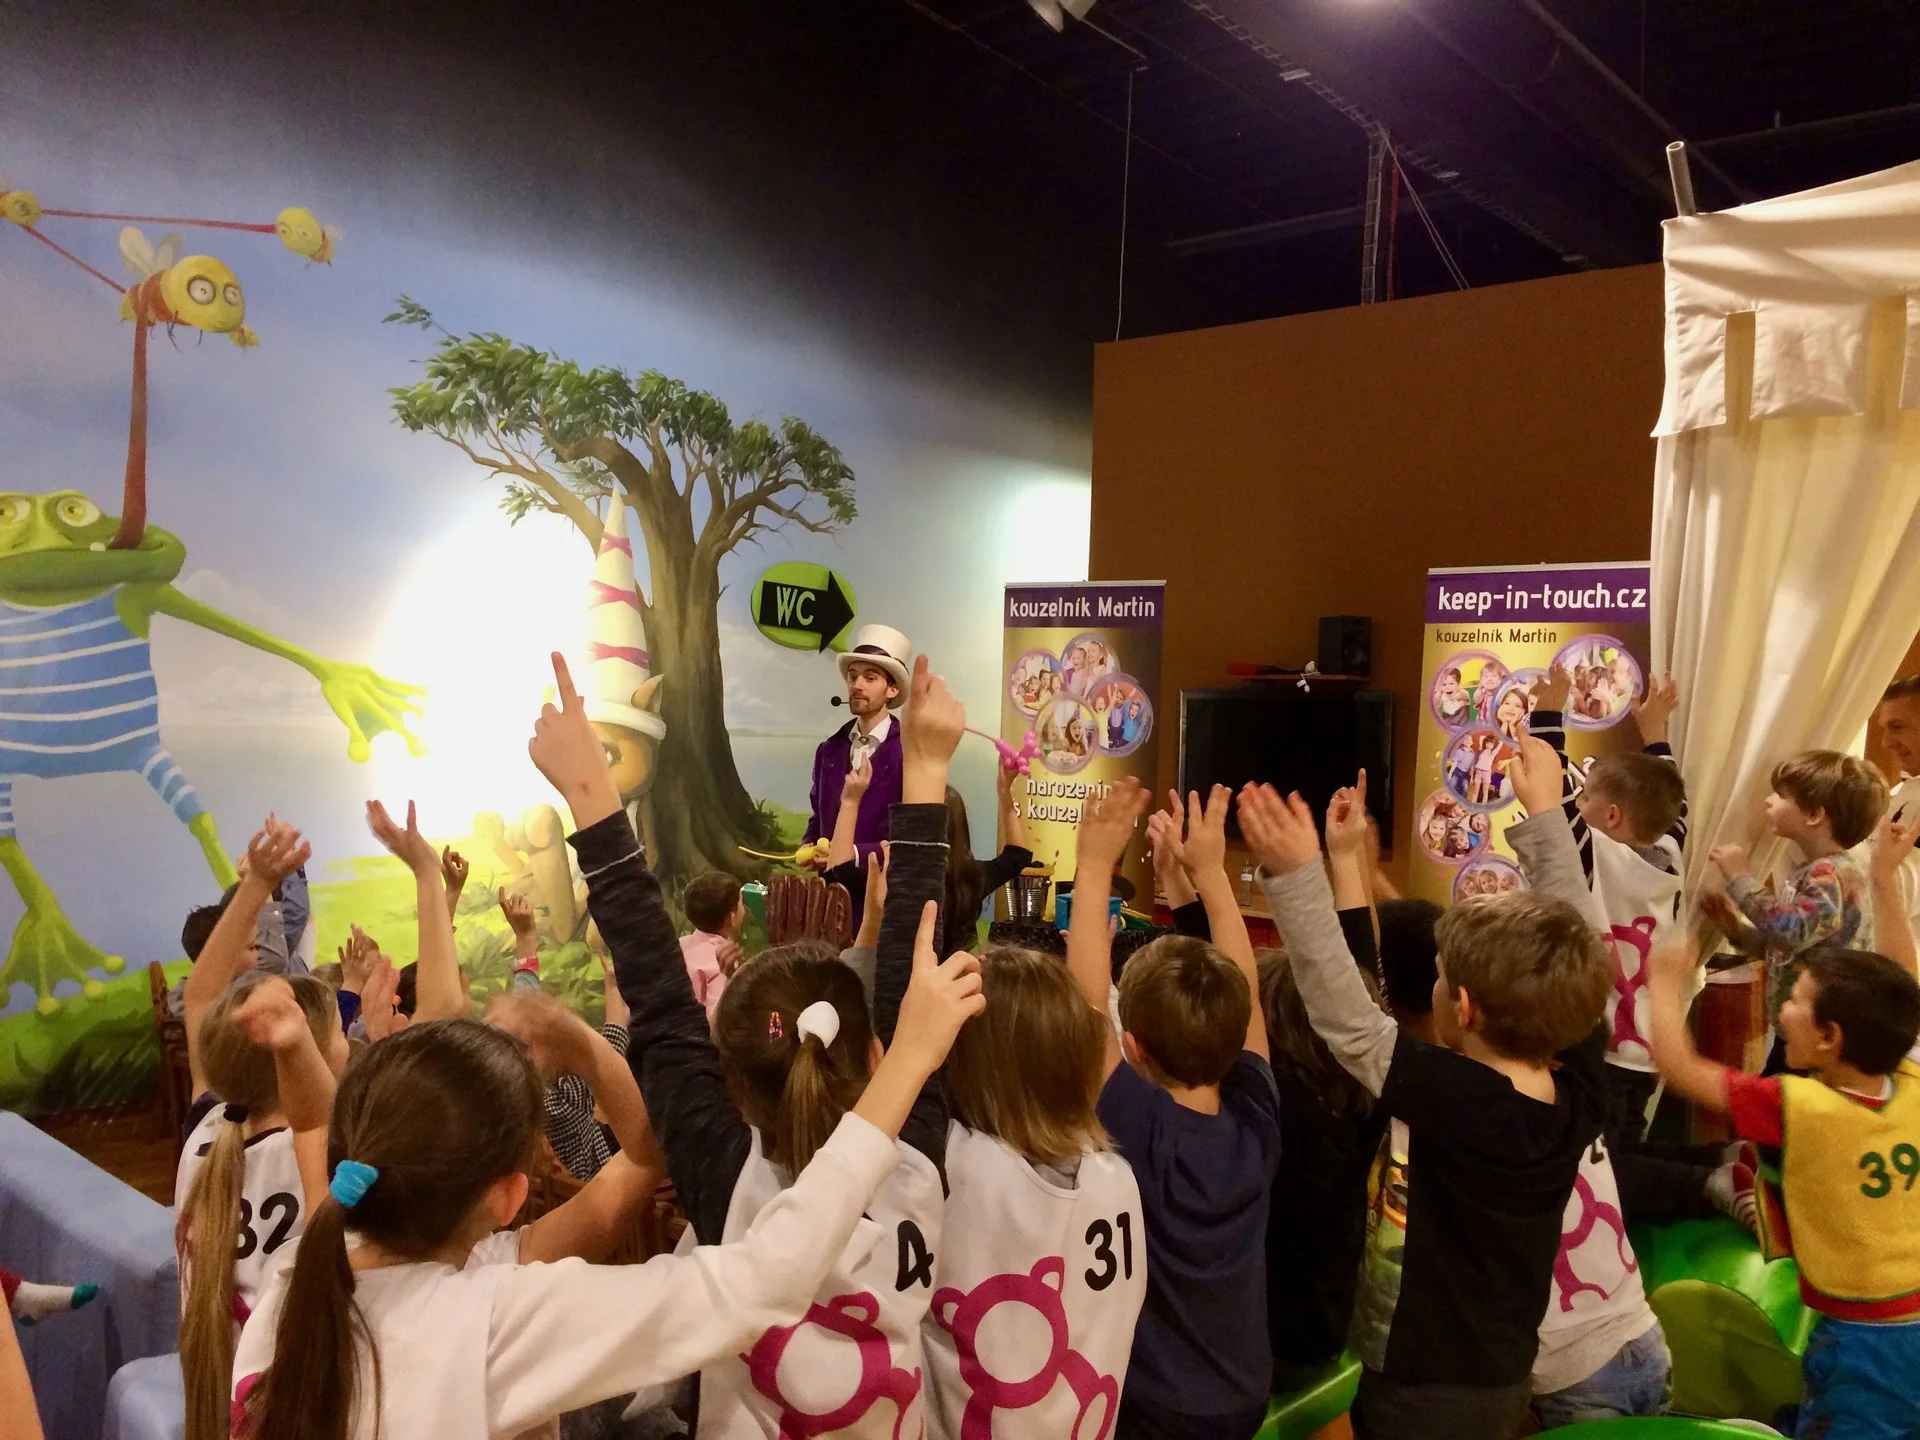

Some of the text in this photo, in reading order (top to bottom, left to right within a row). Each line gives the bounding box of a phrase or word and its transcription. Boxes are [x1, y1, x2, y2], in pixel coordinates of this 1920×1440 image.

[776, 585, 816, 627] WC
[1009, 596, 1155, 618] kouzelník Martin
[1438, 582, 1647, 616] keep-in-touch.cz
[1436, 628, 1557, 644] kouzelník Martin
[1859, 1143, 1920, 1199] 39
[1084, 1210, 1133, 1292] 31
